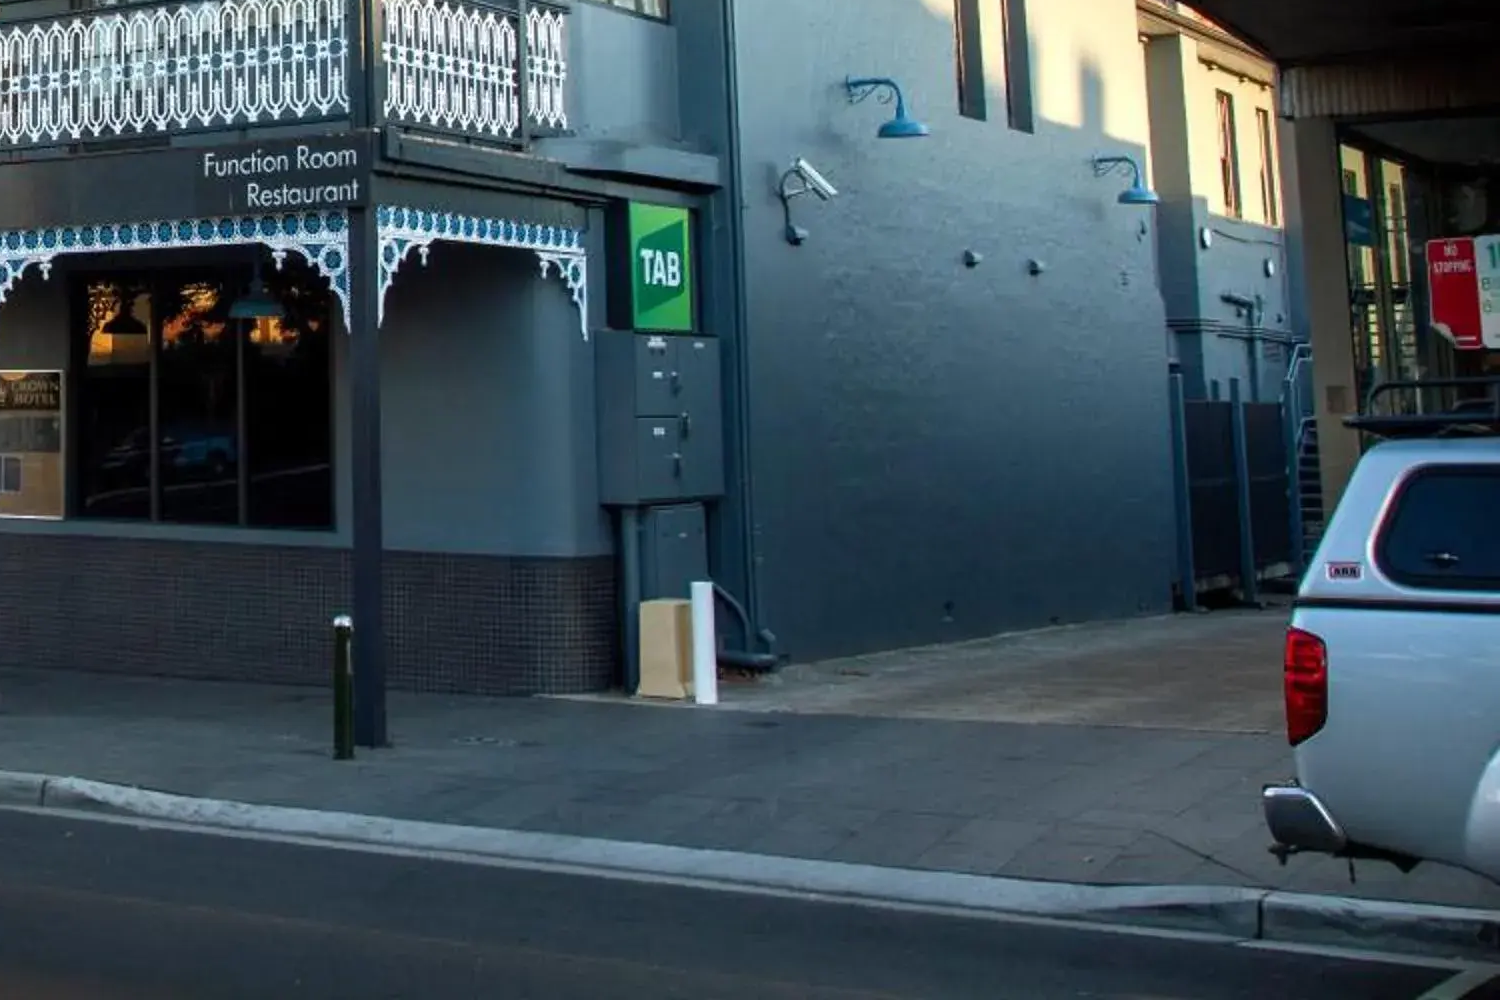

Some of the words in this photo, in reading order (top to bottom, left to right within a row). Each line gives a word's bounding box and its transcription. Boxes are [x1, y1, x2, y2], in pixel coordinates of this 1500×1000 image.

[203, 148, 290, 178] Function
[296, 145, 358, 169] Room
[246, 178, 360, 208] Restaurant
[1443, 243, 1459, 257] NO
[639, 249, 682, 287] TAB
[1432, 259, 1473, 273] STOPPING
